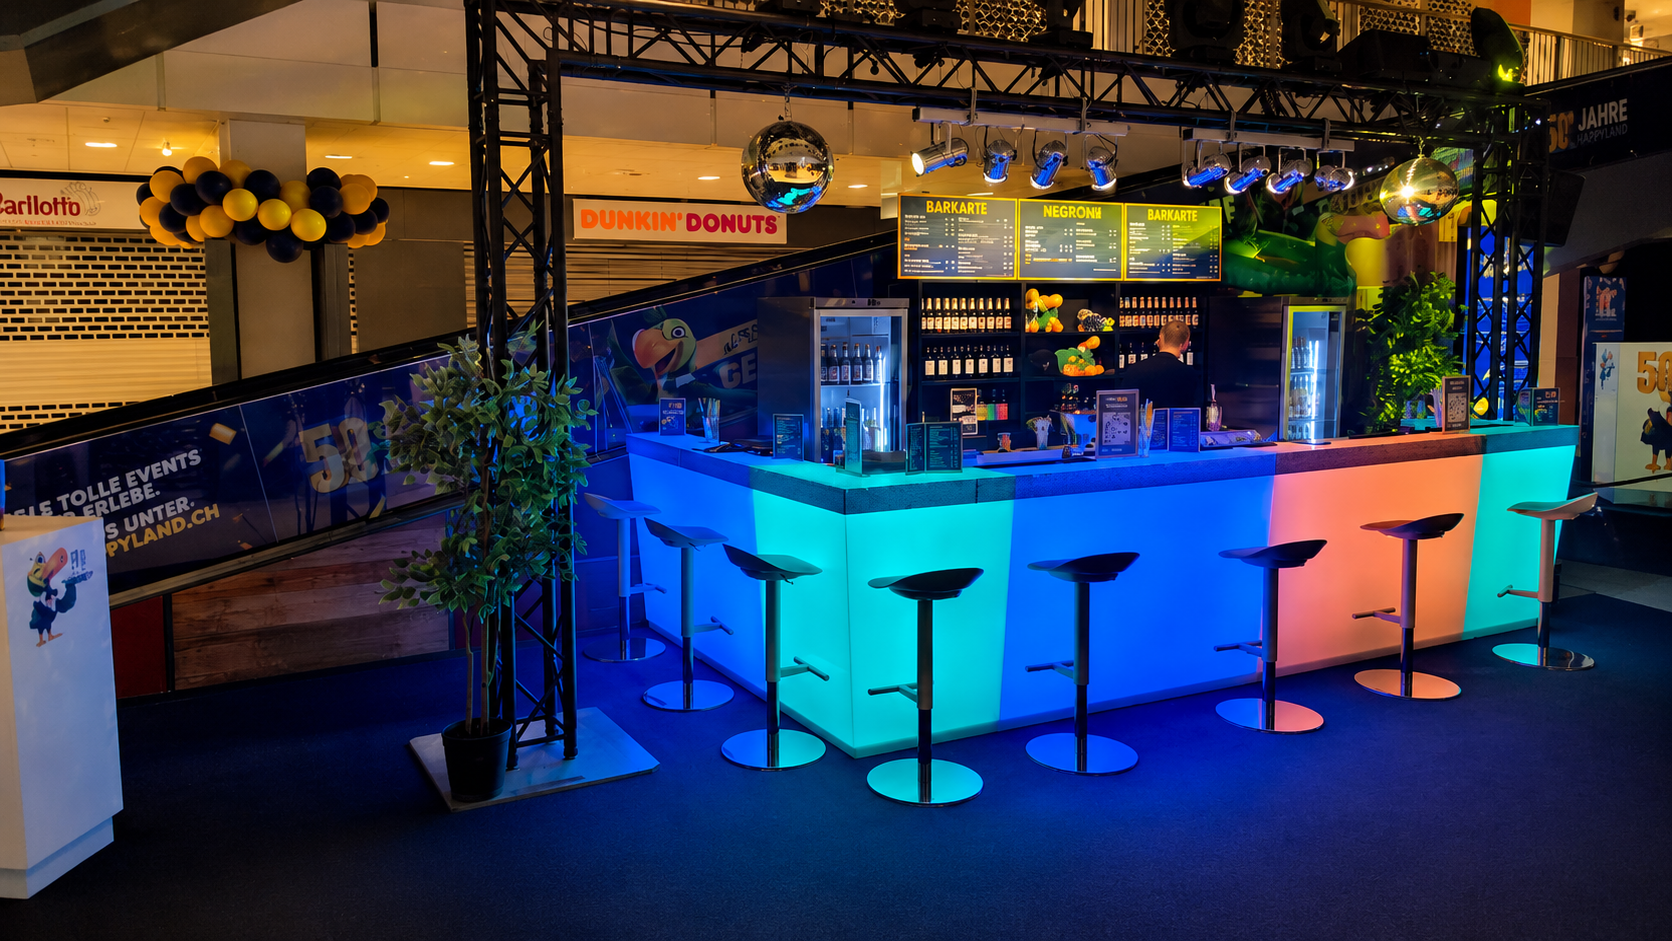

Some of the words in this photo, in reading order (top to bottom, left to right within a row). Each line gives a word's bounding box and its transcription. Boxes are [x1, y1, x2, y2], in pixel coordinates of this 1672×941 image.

[1577, 97, 1628, 132] JAHRE
[1576, 123, 1629, 146] HAPPYLAND
[0, 192, 81, 216] arilotto
[580, 208, 683, 232] DUNKIN'
[686, 212, 778, 235] DONUTS
[926, 200, 988, 215] BARKARTE
[1147, 208, 1198, 222] BARKARTE
[1637, 351, 1672, 394] 50
[57, 476, 121, 511] TOLLE
[125, 449, 201, 490] EVENTS
[83, 482, 161, 517] ERLEBE.
[124, 496, 195, 533] UNTER.
[106, 503, 220, 558] PYLAND.CH
